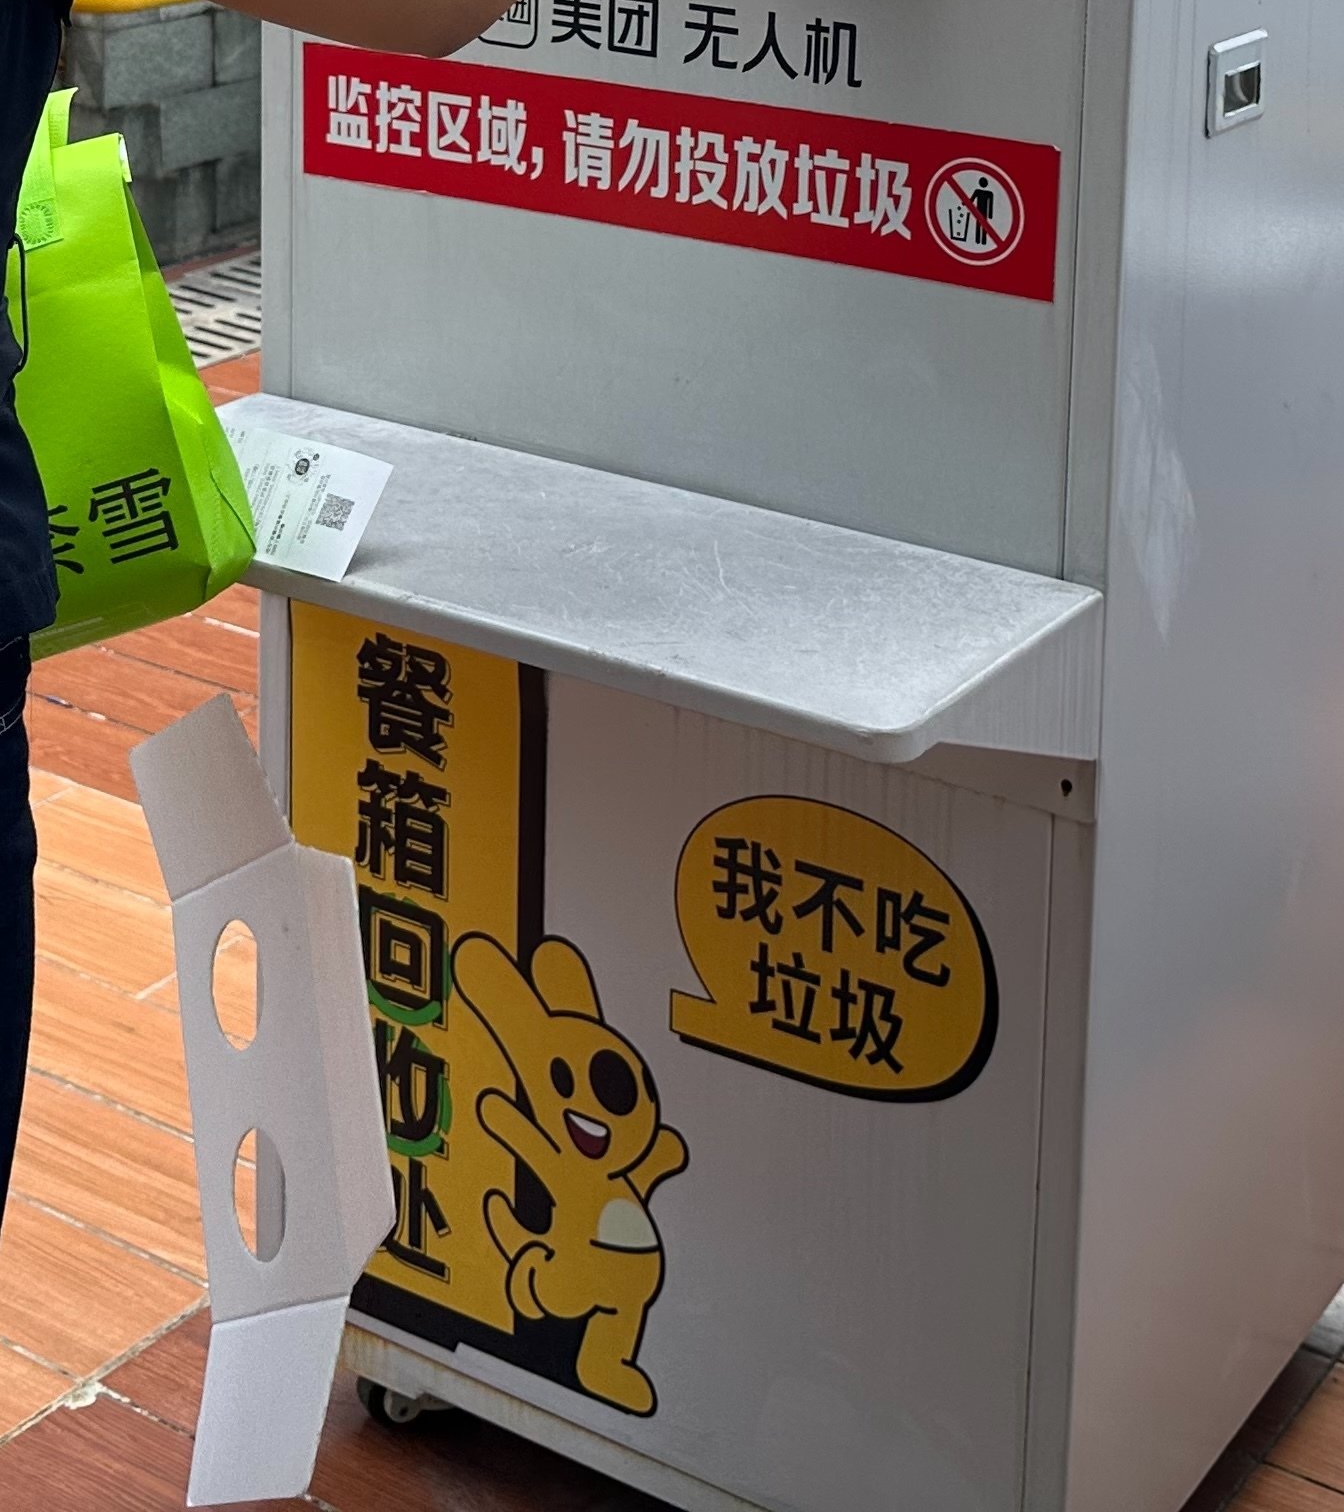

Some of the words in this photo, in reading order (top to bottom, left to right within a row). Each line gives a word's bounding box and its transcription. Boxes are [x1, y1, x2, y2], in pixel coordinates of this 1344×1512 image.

[683, 2, 863, 88] 无人机
[712, 836, 951, 988] 我不吃
[748, 941, 904, 1074] 垃圾
